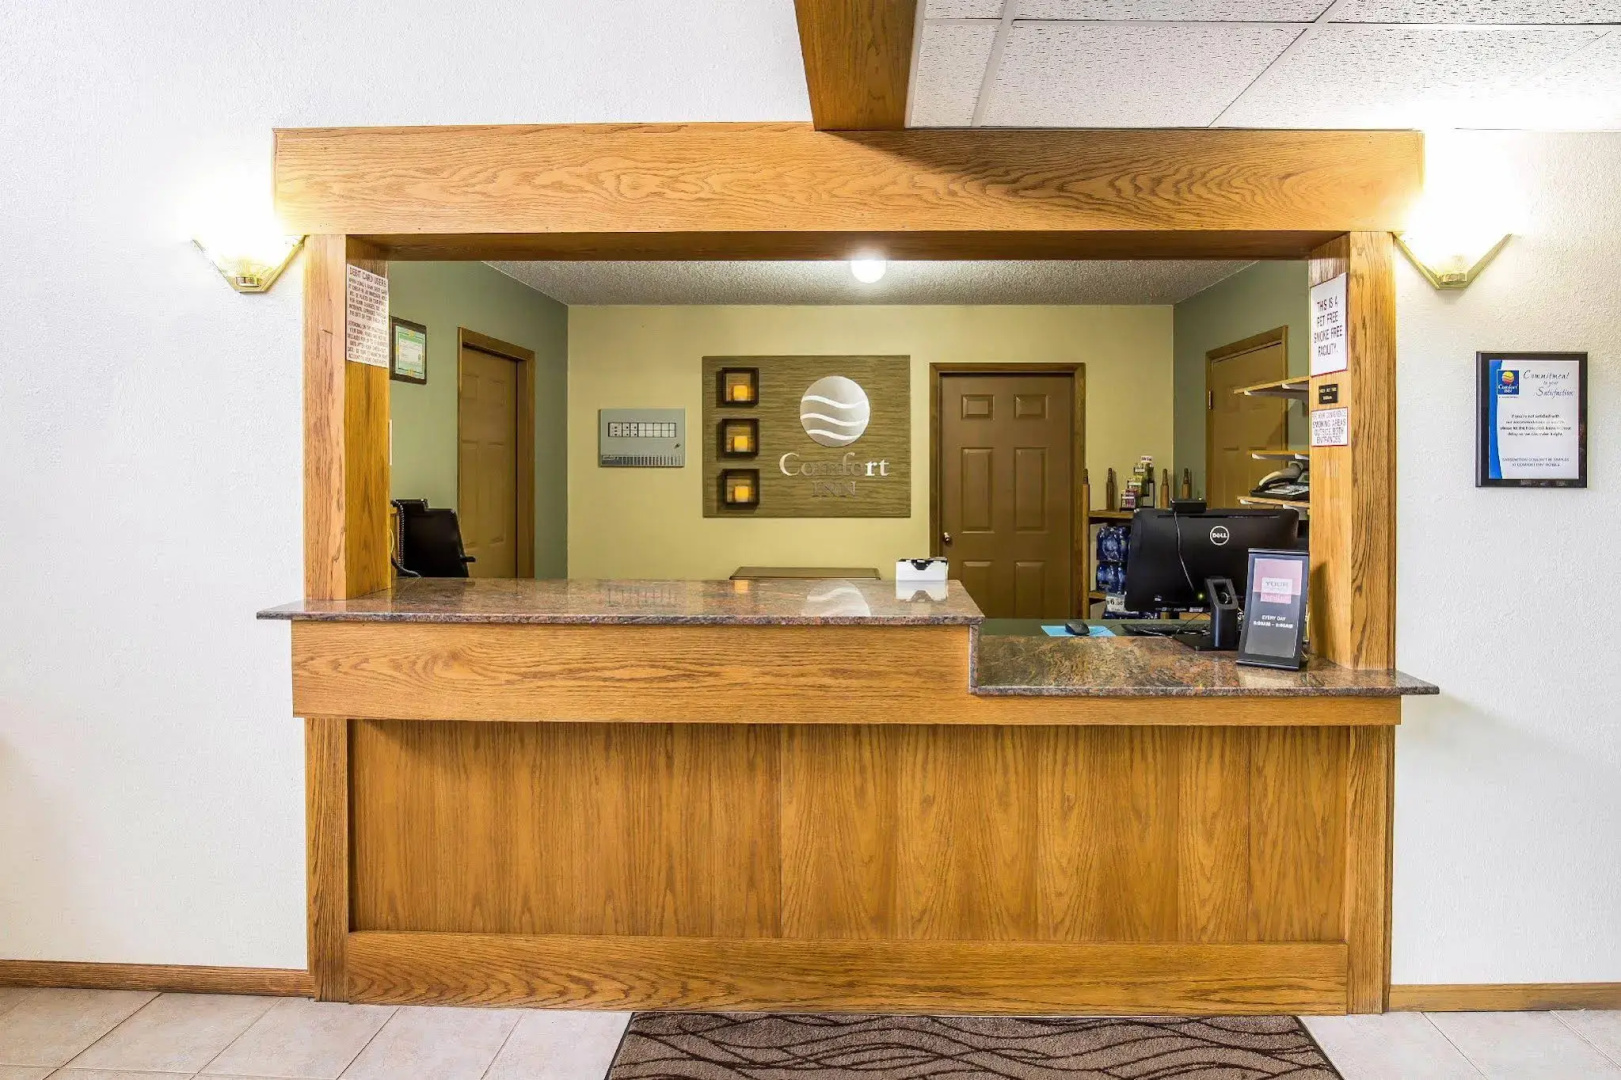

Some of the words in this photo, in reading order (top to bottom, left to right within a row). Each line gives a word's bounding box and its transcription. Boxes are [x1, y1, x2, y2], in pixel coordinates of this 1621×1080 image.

[350, 266, 361, 278] DEBIT
[362, 271, 374, 282] CARD
[374, 276, 387, 287] USERS
[1317, 299, 1327, 312] THIS
[1328, 297, 1333, 308] IS
[1317, 314, 1325, 327] PET
[1327, 311, 1338, 325] FREE
[1314, 329, 1329, 343] SMOKE
[1330, 325, 1343, 339] FREE
[1523, 369, 1570, 380] Commitment
[1534, 386, 1574, 399] Satisfaction
[1313, 419, 1331, 429] SMOKING
[779, 452, 890, 476] Comfort
[812, 481, 857, 497] INN
